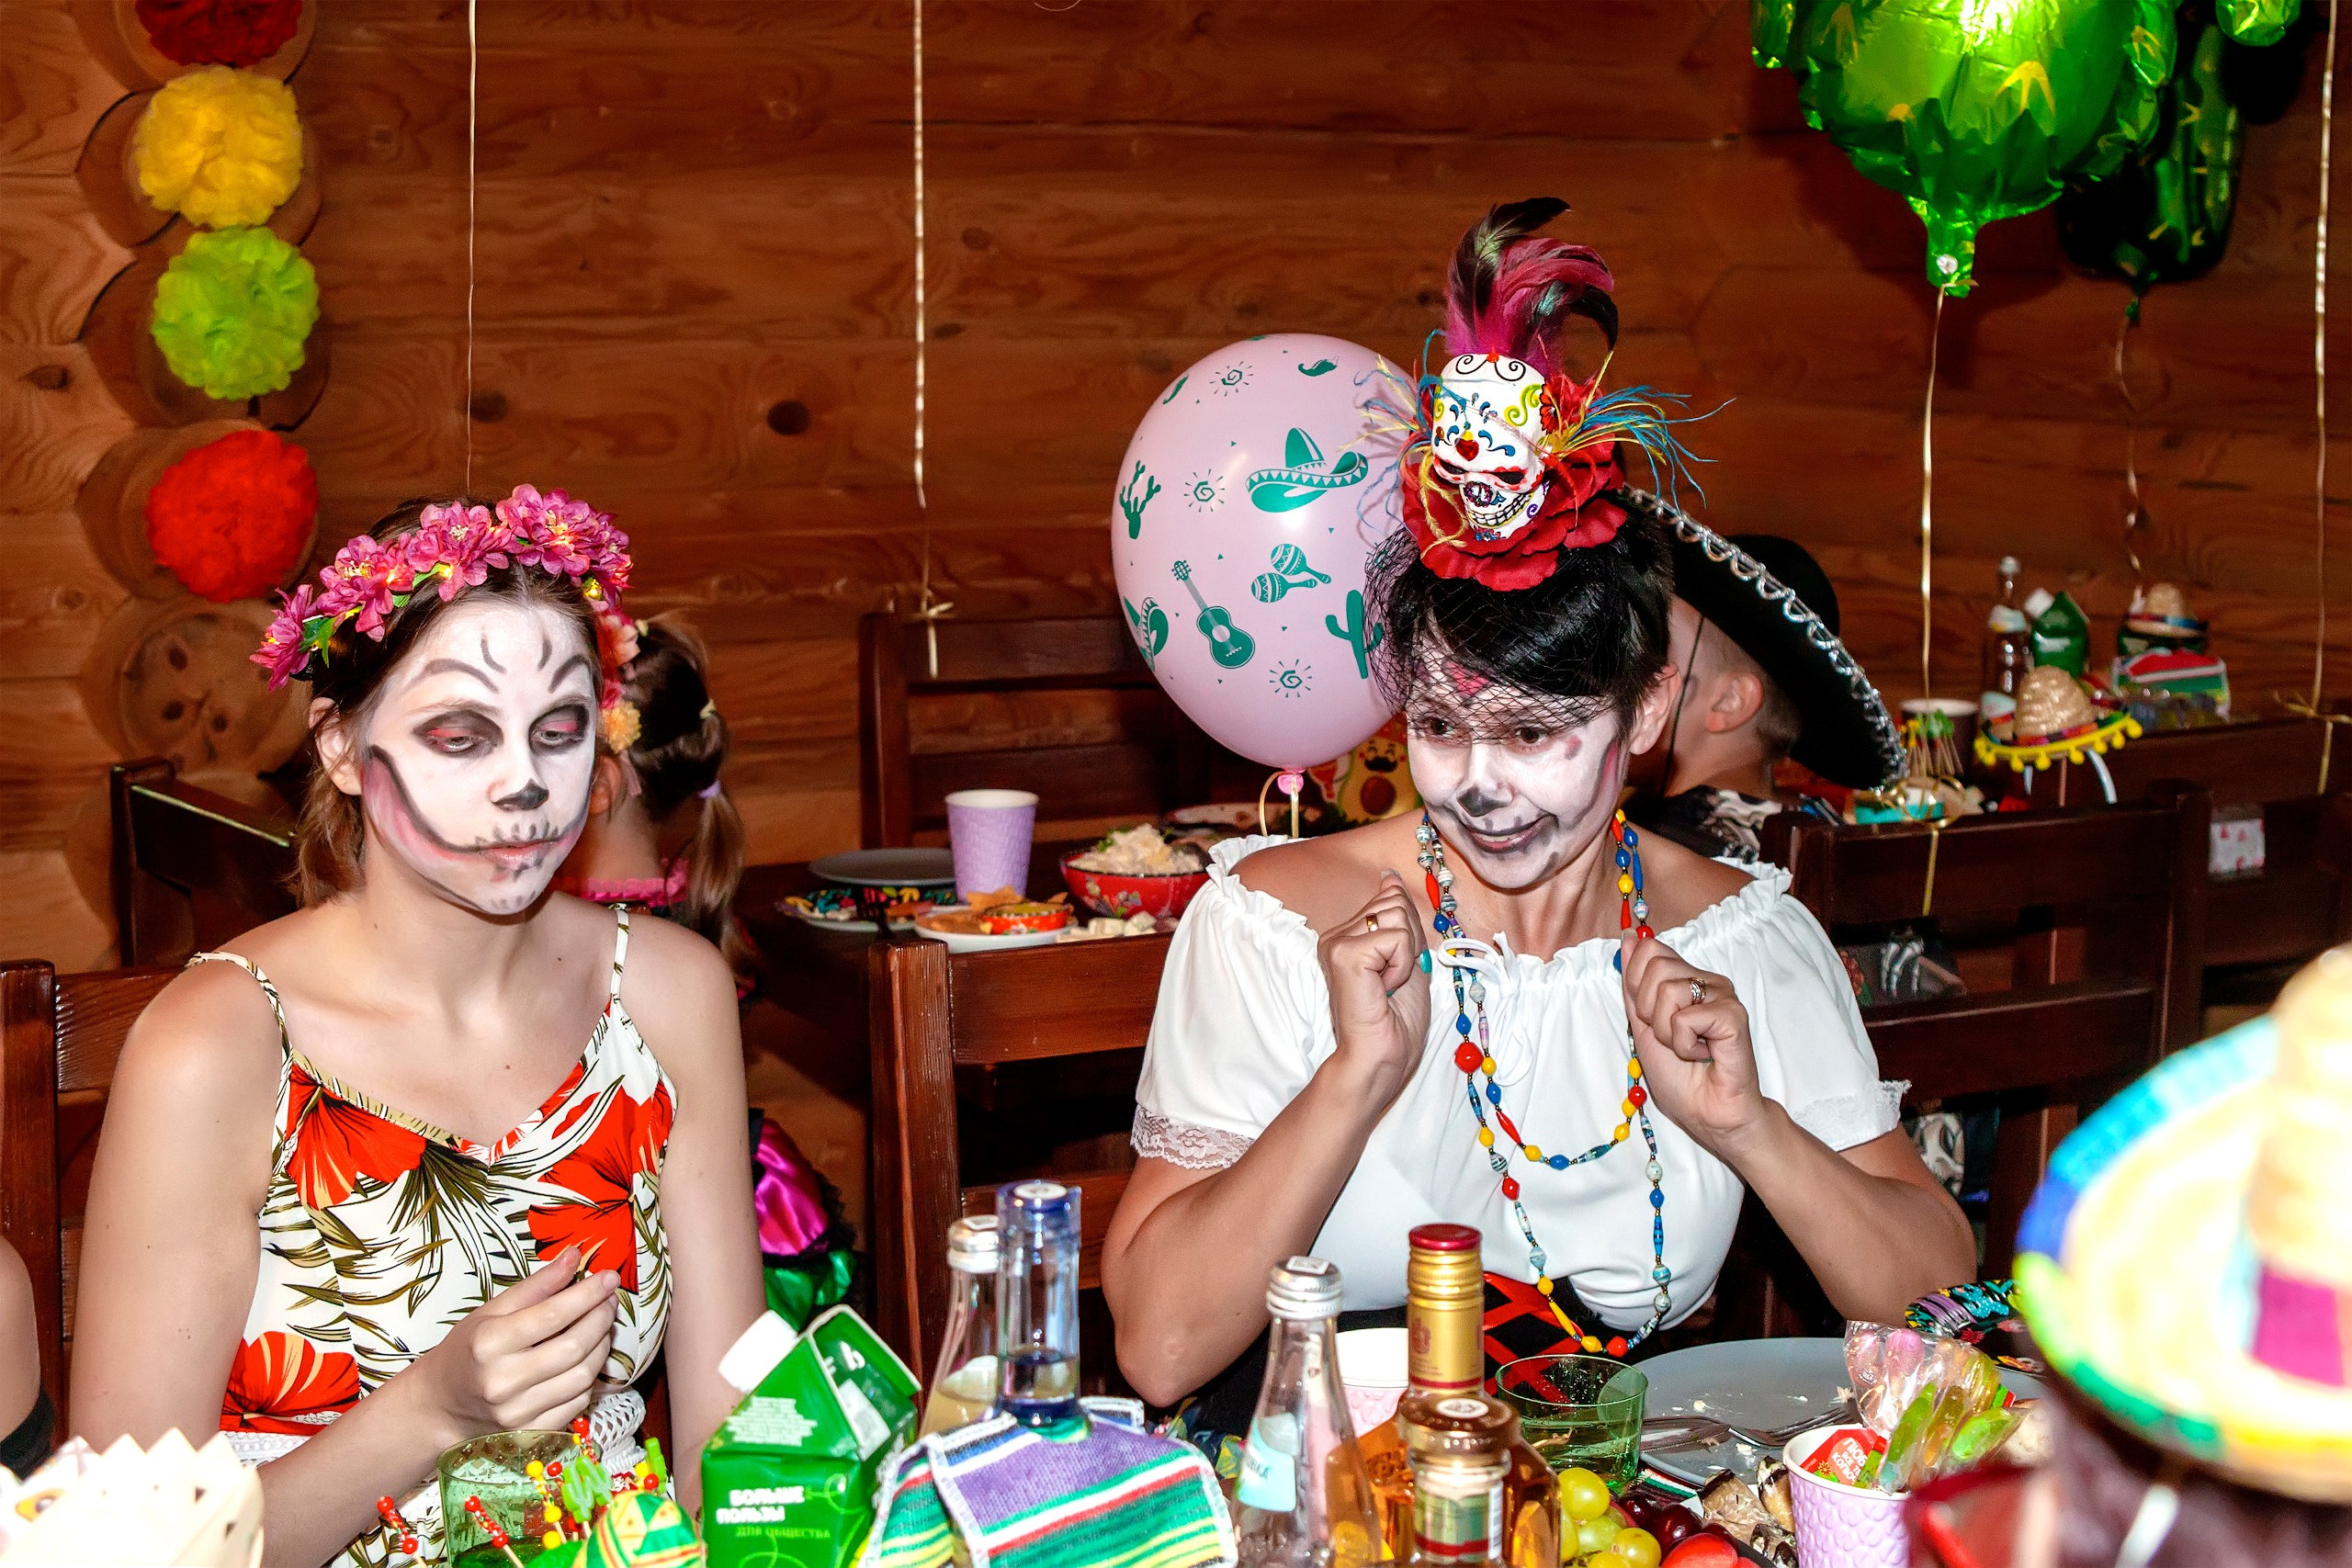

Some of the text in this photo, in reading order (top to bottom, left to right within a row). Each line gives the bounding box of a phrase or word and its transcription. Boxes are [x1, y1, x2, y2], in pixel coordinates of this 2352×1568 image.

[1841, 1451, 1854, 1467] ВСЕ
[1843, 1437, 1868, 1467] ЛЮБ
[1831, 1451, 1856, 1484] КОЛЮЧ
[729, 1485, 805, 1506] БОЛЬШЕ
[716, 1506, 786, 1524] ПОЛЬЗЫ
[736, 1526, 831, 1539] ДЛЯ ОБЩЕСТВА
